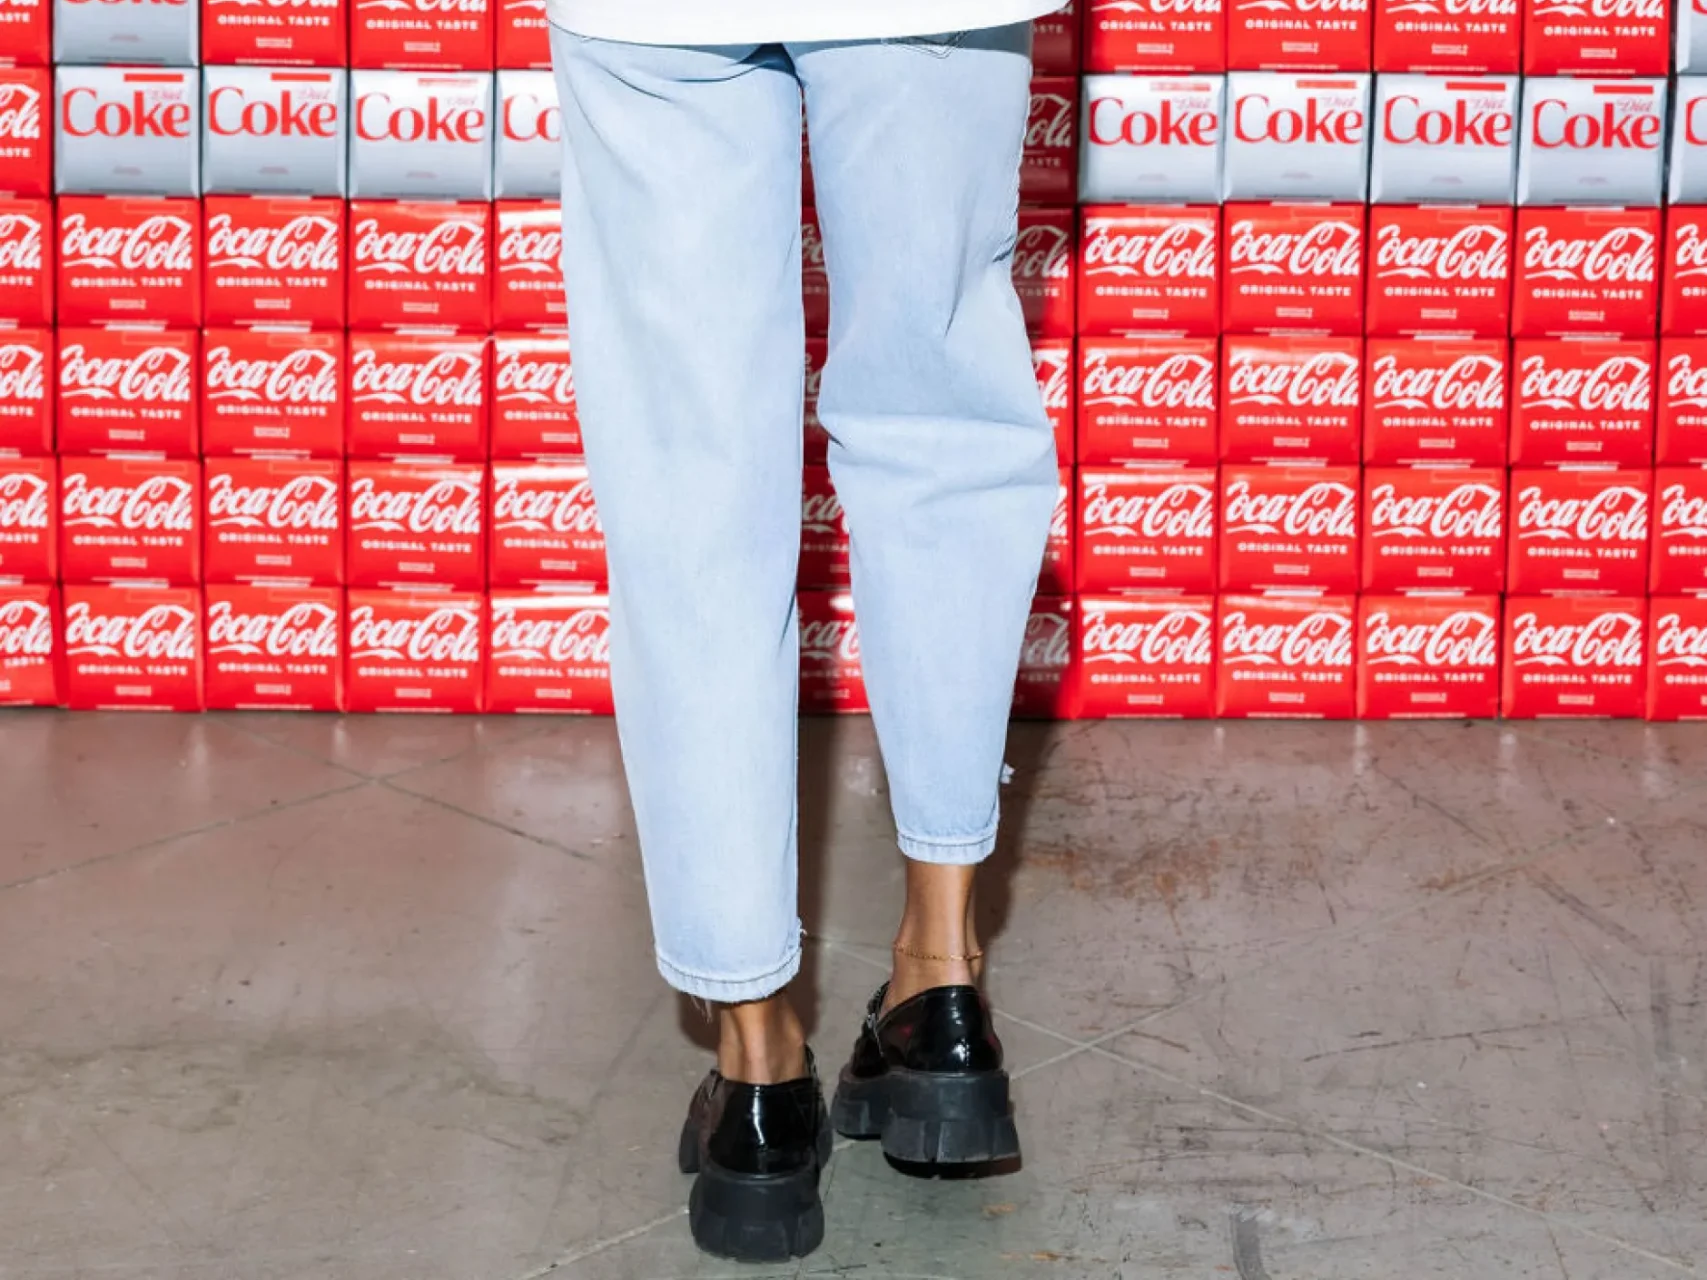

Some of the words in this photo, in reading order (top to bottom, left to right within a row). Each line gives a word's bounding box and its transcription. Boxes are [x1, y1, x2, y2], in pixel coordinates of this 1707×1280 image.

[218, 14, 283, 25] ORIGINAL
[287, 14, 328, 25] TASTE
[1396, 21, 1461, 32] ORIGINAL
[1465, 21, 1506, 32] TASTE
[1544, 25, 1610, 36] ORIGINAL
[1614, 25, 1656, 36] TASTE
[62, 87, 189, 137] Coke
[209, 86, 336, 136] Coke
[356, 94, 483, 141] Coke
[1089, 96, 1216, 146] Coke
[1234, 94, 1361, 144] Coke
[1384, 95, 1511, 145] Coke
[1532, 99, 1659, 149] Coke
[71, 277, 136, 288] ORIGINAL
[141, 277, 182, 288] TASTE
[216, 276, 282, 287] ORIGINAL
[286, 276, 328, 287] TASTE
[1240, 285, 1305, 296] ORIGINAL
[1309, 285, 1350, 296] TASTE
[1532, 288, 1597, 299] ORIGINAL
[1601, 288, 1642, 299] TASTE
[71, 406, 136, 419] ORIGINAL
[140, 406, 181, 419] TASTE
[1382, 416, 1448, 427] ORIGINAL
[1452, 416, 1494, 427] TASTE
[1530, 420, 1596, 431] ORIGINAL
[1600, 420, 1642, 431] TASTE
[218, 532, 283, 544] ORIGINAL
[287, 532, 328, 544] TASTE
[1237, 542, 1302, 553] ORIGINAL
[1306, 542, 1347, 553] TASTE
[1380, 545, 1446, 556] ORIGINAL
[1450, 545, 1492, 556] TASTE
[77, 664, 142, 675] ORIGINAL
[146, 664, 187, 675] TASTE
[1522, 673, 1587, 684] ORIGINAL
[1591, 673, 1632, 684] TASTE
